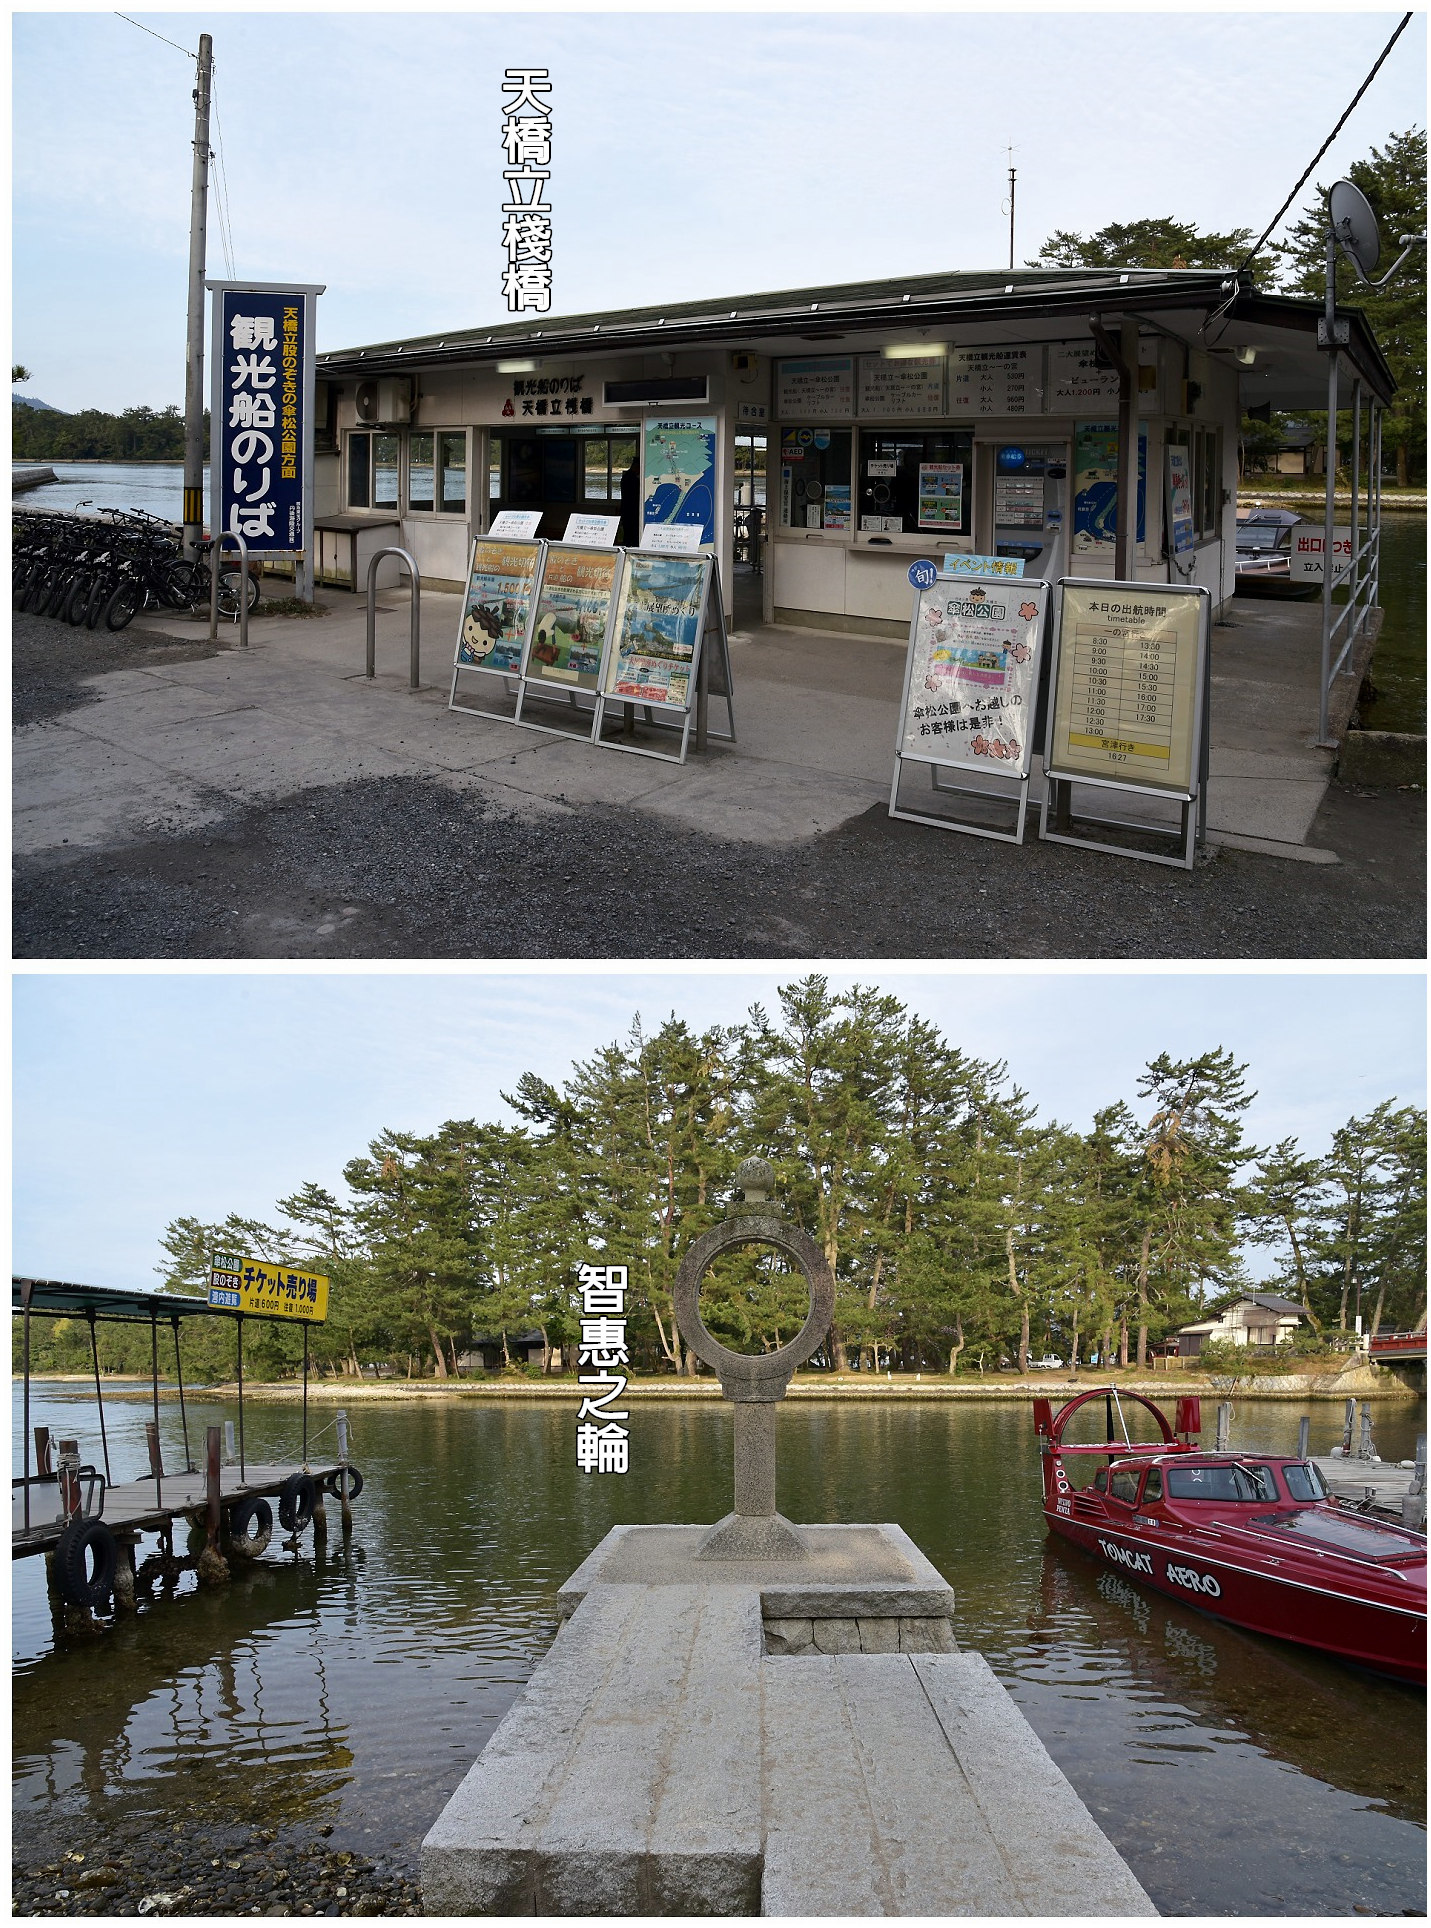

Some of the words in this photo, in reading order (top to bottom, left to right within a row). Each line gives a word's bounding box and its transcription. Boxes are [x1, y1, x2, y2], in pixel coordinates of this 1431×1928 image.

[281, 307, 298, 479] 天橋立股のぞきの傘松公園方面
[514, 375, 584, 396] 観光船のりば
[1007, 384, 1025, 392] 270円
[229, 313, 278, 537] 観光船のりば
[1298, 537, 1352, 554] 出口つき
[949, 558, 1018, 575] イベント情報
[1304, 562, 1343, 573] 立入止
[947, 601, 1006, 620] 傘松公園
[1089, 601, 1167, 617] 本日の出航時間
[1107, 615, 1145, 625] timetable
[1140, 643, 1160, 651] 13:30
[1140, 653, 1160, 661] 14:00
[1089, 667, 1108, 675] 10:00
[1139, 673, 1158, 681] 15:00
[1139, 663, 1159, 671] 14:30
[1088, 677, 1107, 685] 10:30
[1138, 683, 1157, 691] 15:30
[1087, 687, 1107, 695] 11:00
[1137, 694, 1157, 702] 16:00
[913, 694, 1022, 719] 傘松公園へお越しの
[1087, 698, 1105, 706] 11:30
[1136, 704, 1156, 712] 17:00
[1085, 717, 1104, 725] 12:30
[1086, 707, 1105, 715] 12:00
[1136, 714, 1156, 722] 17:30
[1085, 727, 1103, 735] 13:00
[1101, 740, 1135, 751] 宮津行き
[213, 1254, 240, 1272] 傘松公園
[212, 1272, 239, 1289] 股のぞき
[243, 1266, 318, 1303] チケット売り場
[249, 1297, 259, 1309] 片道
[261, 1299, 280, 1311] 600円
[1098, 1538, 1153, 1575] TOMCAT
[1166, 1562, 1221, 1598] AERO
